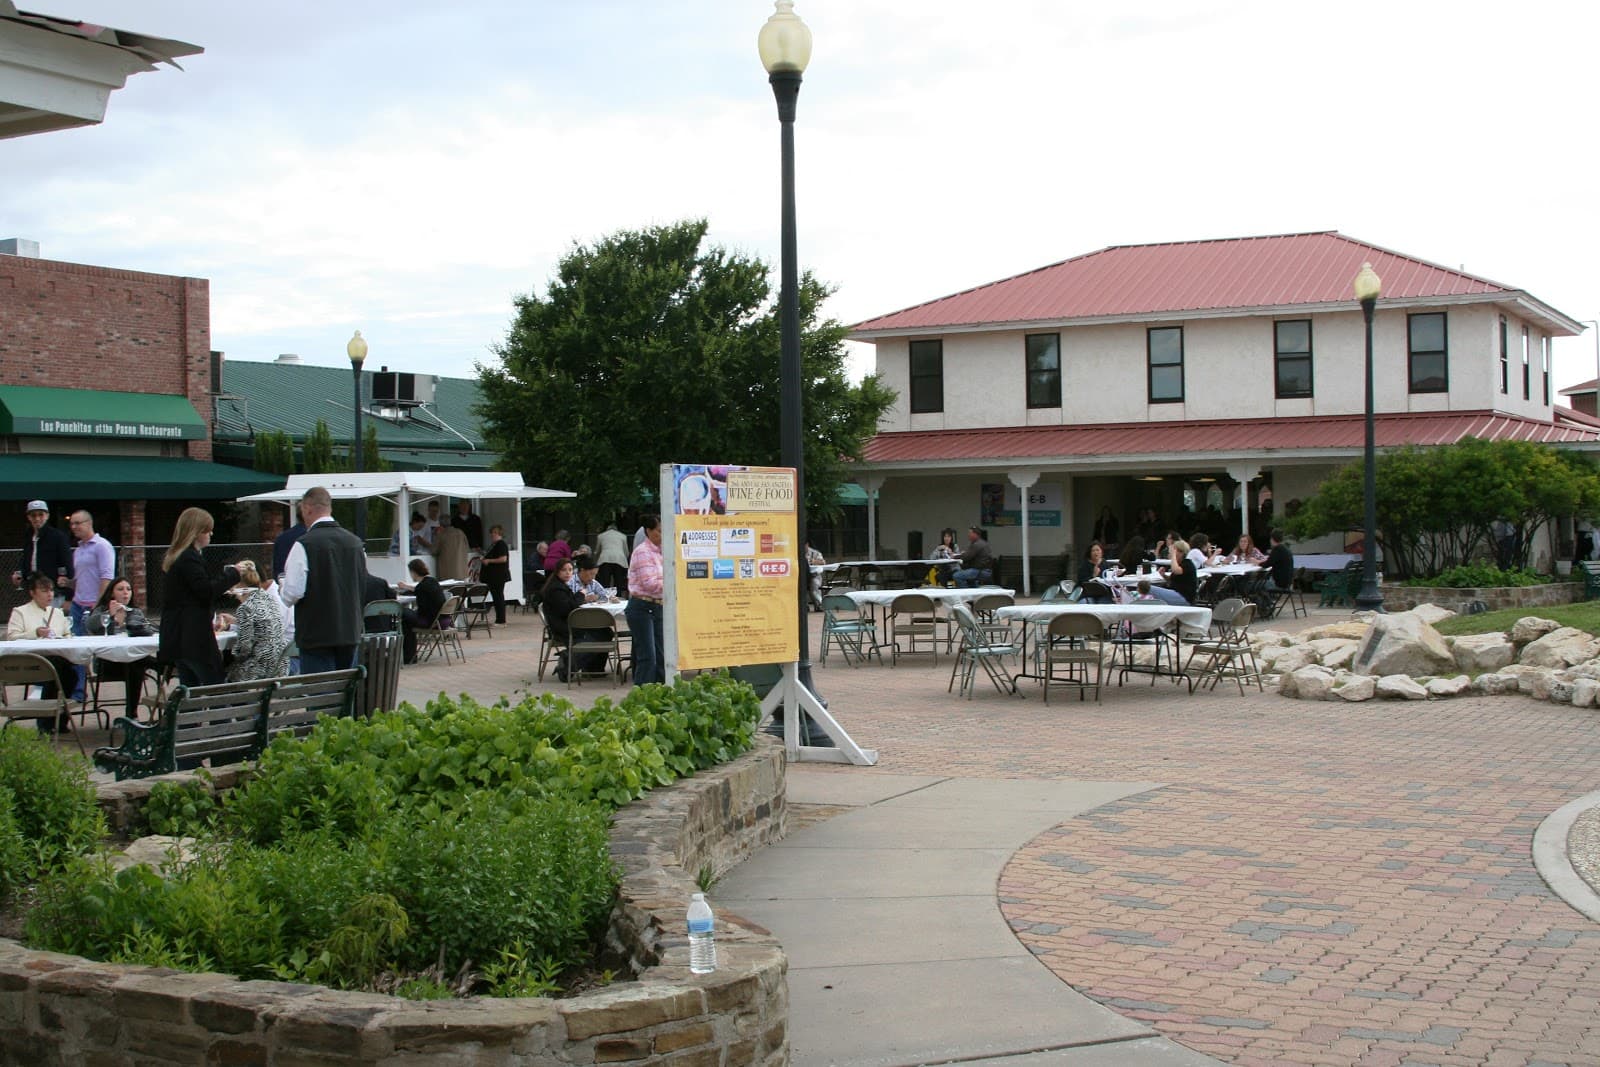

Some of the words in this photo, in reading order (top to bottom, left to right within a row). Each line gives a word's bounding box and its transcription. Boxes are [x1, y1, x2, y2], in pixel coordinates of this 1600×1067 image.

[40, 420, 54, 432] Los
[55, 421, 92, 433] Panchitos
[729, 487, 754, 500] WINE
[755, 488, 762, 500] &
[765, 488, 793, 500] FOOD
[688, 532, 717, 541] ADDRESSES
[762, 564, 787, 574] H-E-B
